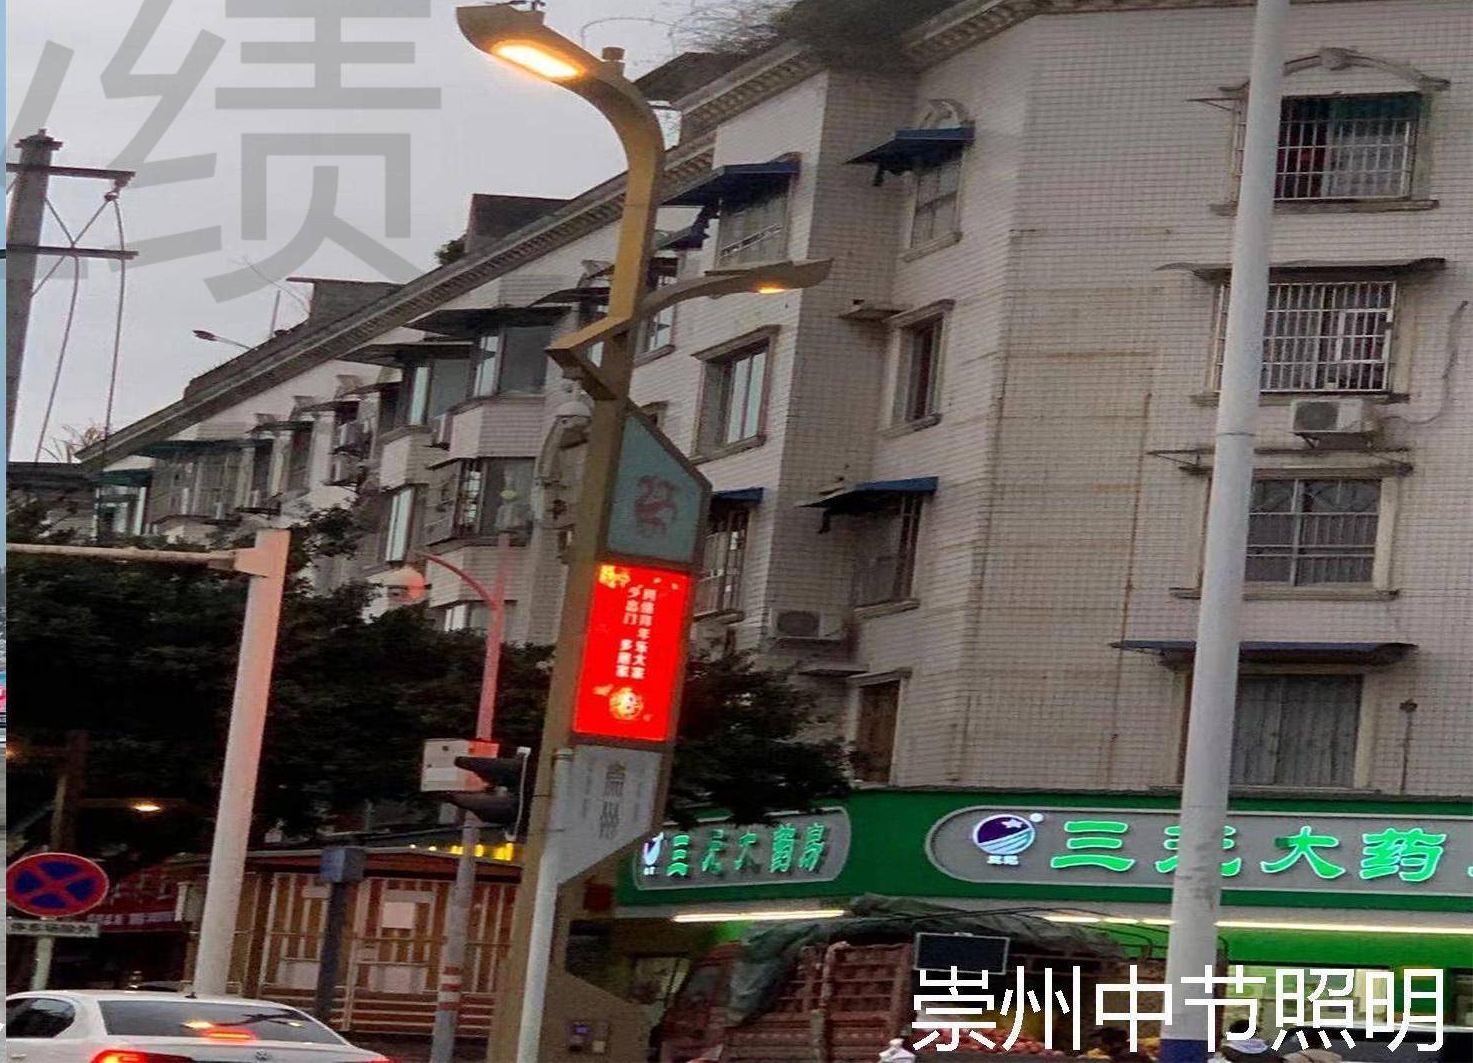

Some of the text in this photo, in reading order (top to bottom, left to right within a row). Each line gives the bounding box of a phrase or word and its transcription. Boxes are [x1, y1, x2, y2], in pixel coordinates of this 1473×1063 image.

[666, 823, 826, 877] 三元大药房
[1049, 820, 1473, 882] 三大药
